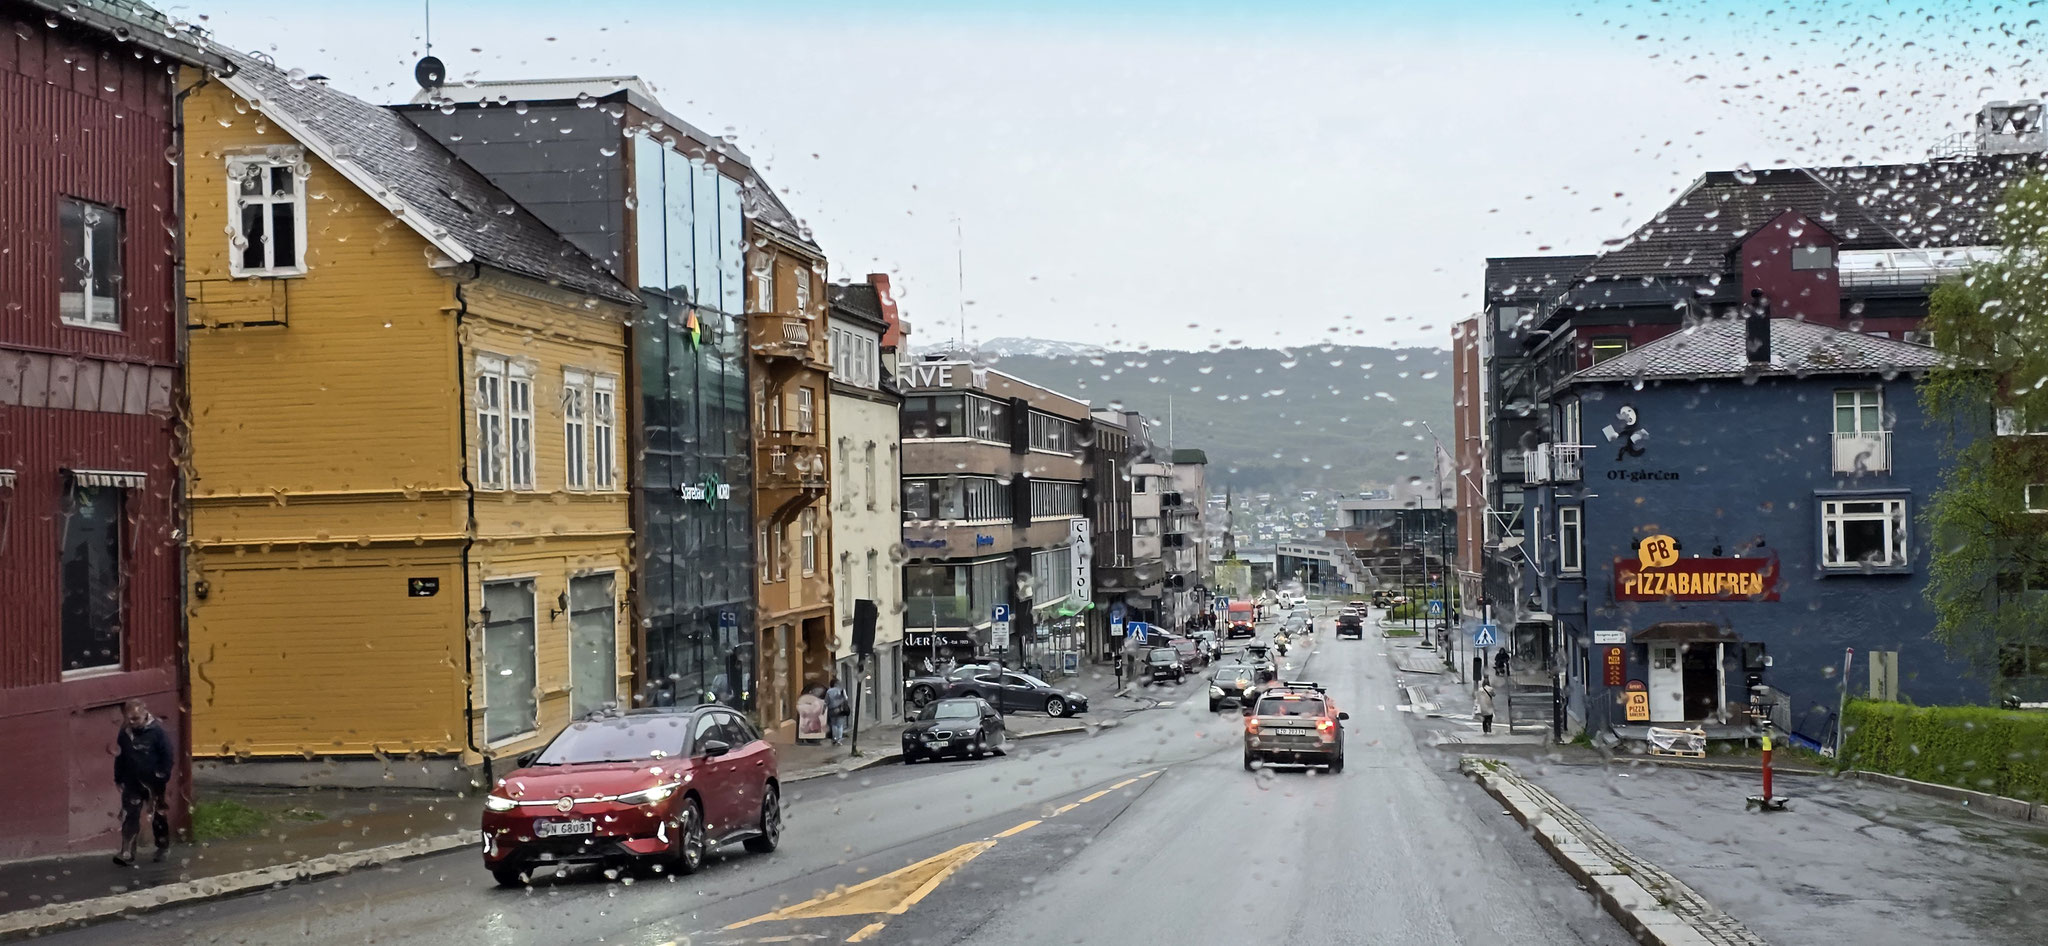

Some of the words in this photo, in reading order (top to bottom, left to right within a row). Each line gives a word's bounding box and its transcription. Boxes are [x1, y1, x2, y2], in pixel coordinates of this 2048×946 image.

[1607, 469, 1680, 483] OT-gården
[1076, 523, 1085, 598] CAITOL
[1647, 540, 1670, 561] PB
[1625, 573, 1763, 595] PIZZABAKEREN
[995, 606, 1005, 620] P
